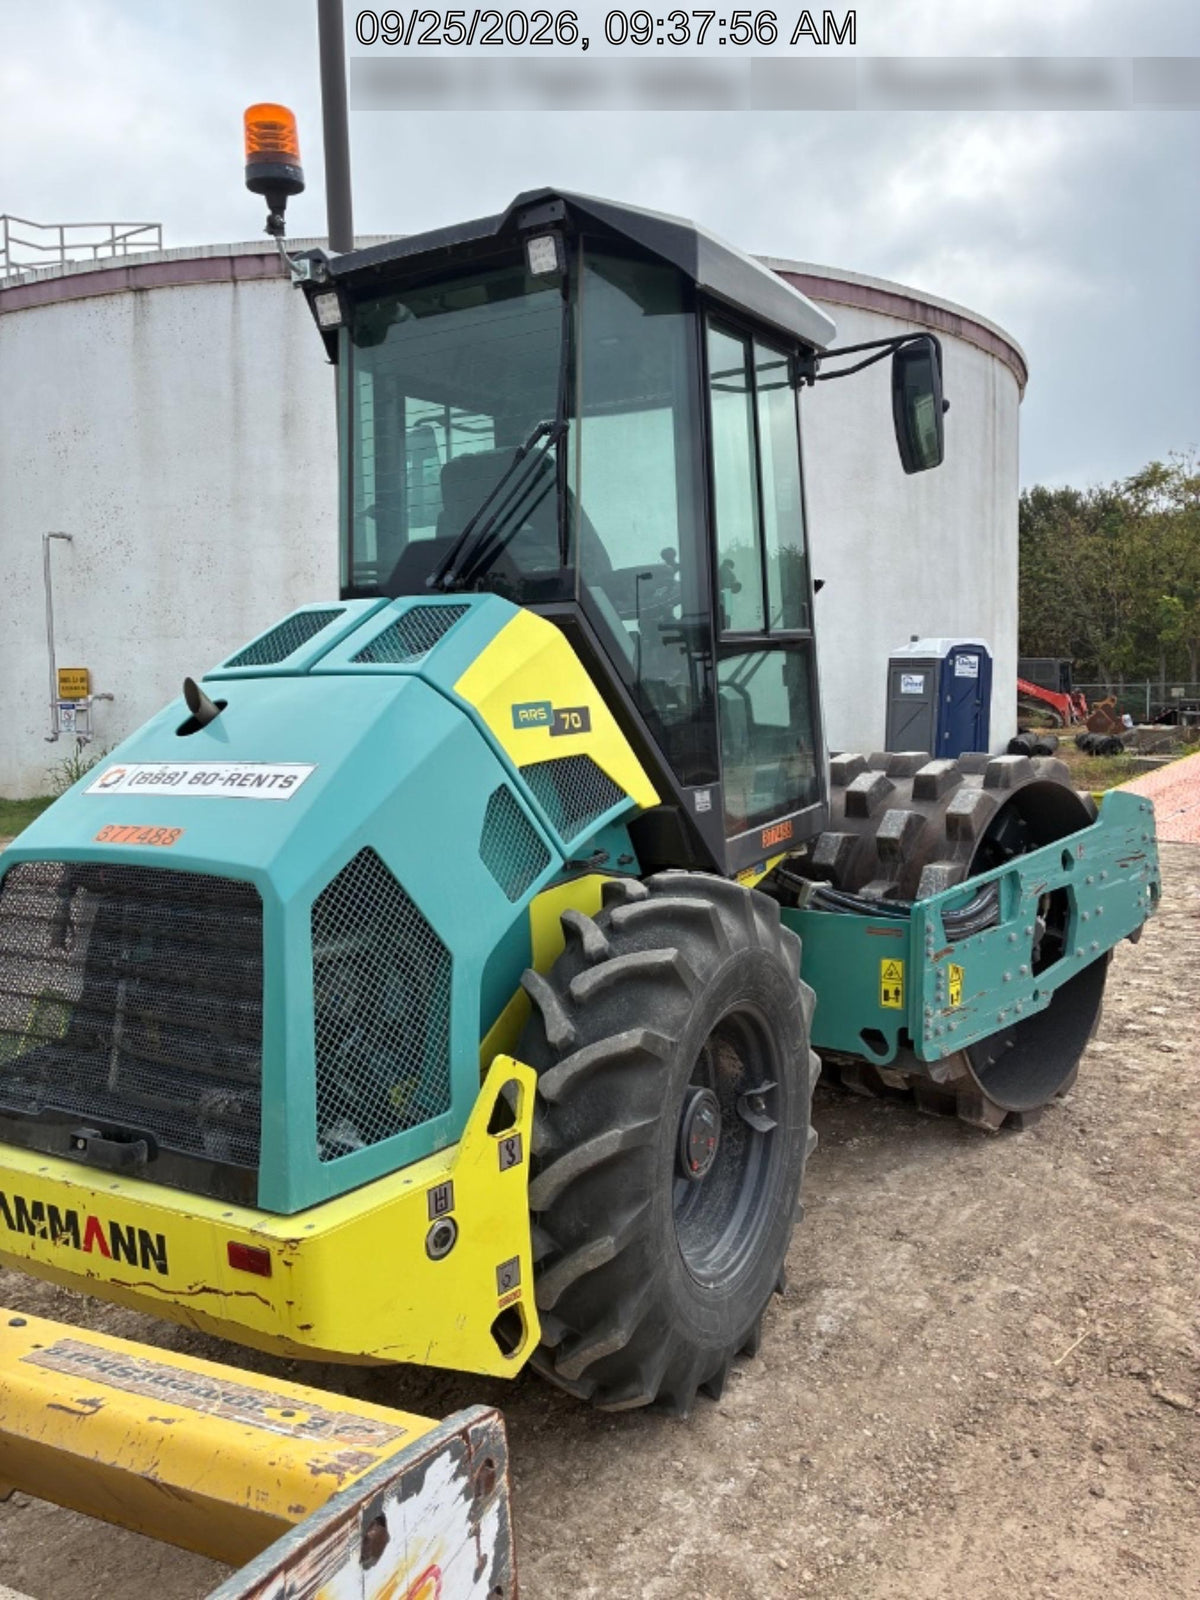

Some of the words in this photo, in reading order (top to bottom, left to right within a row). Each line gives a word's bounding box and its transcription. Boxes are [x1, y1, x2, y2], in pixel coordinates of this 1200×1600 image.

[518, 707, 548, 723] ARS
[559, 711, 582, 730] 70
[127, 771, 188, 787] (888)
[188, 771, 298, 789] 80-RENTS
[95, 824, 183, 846] 377488
